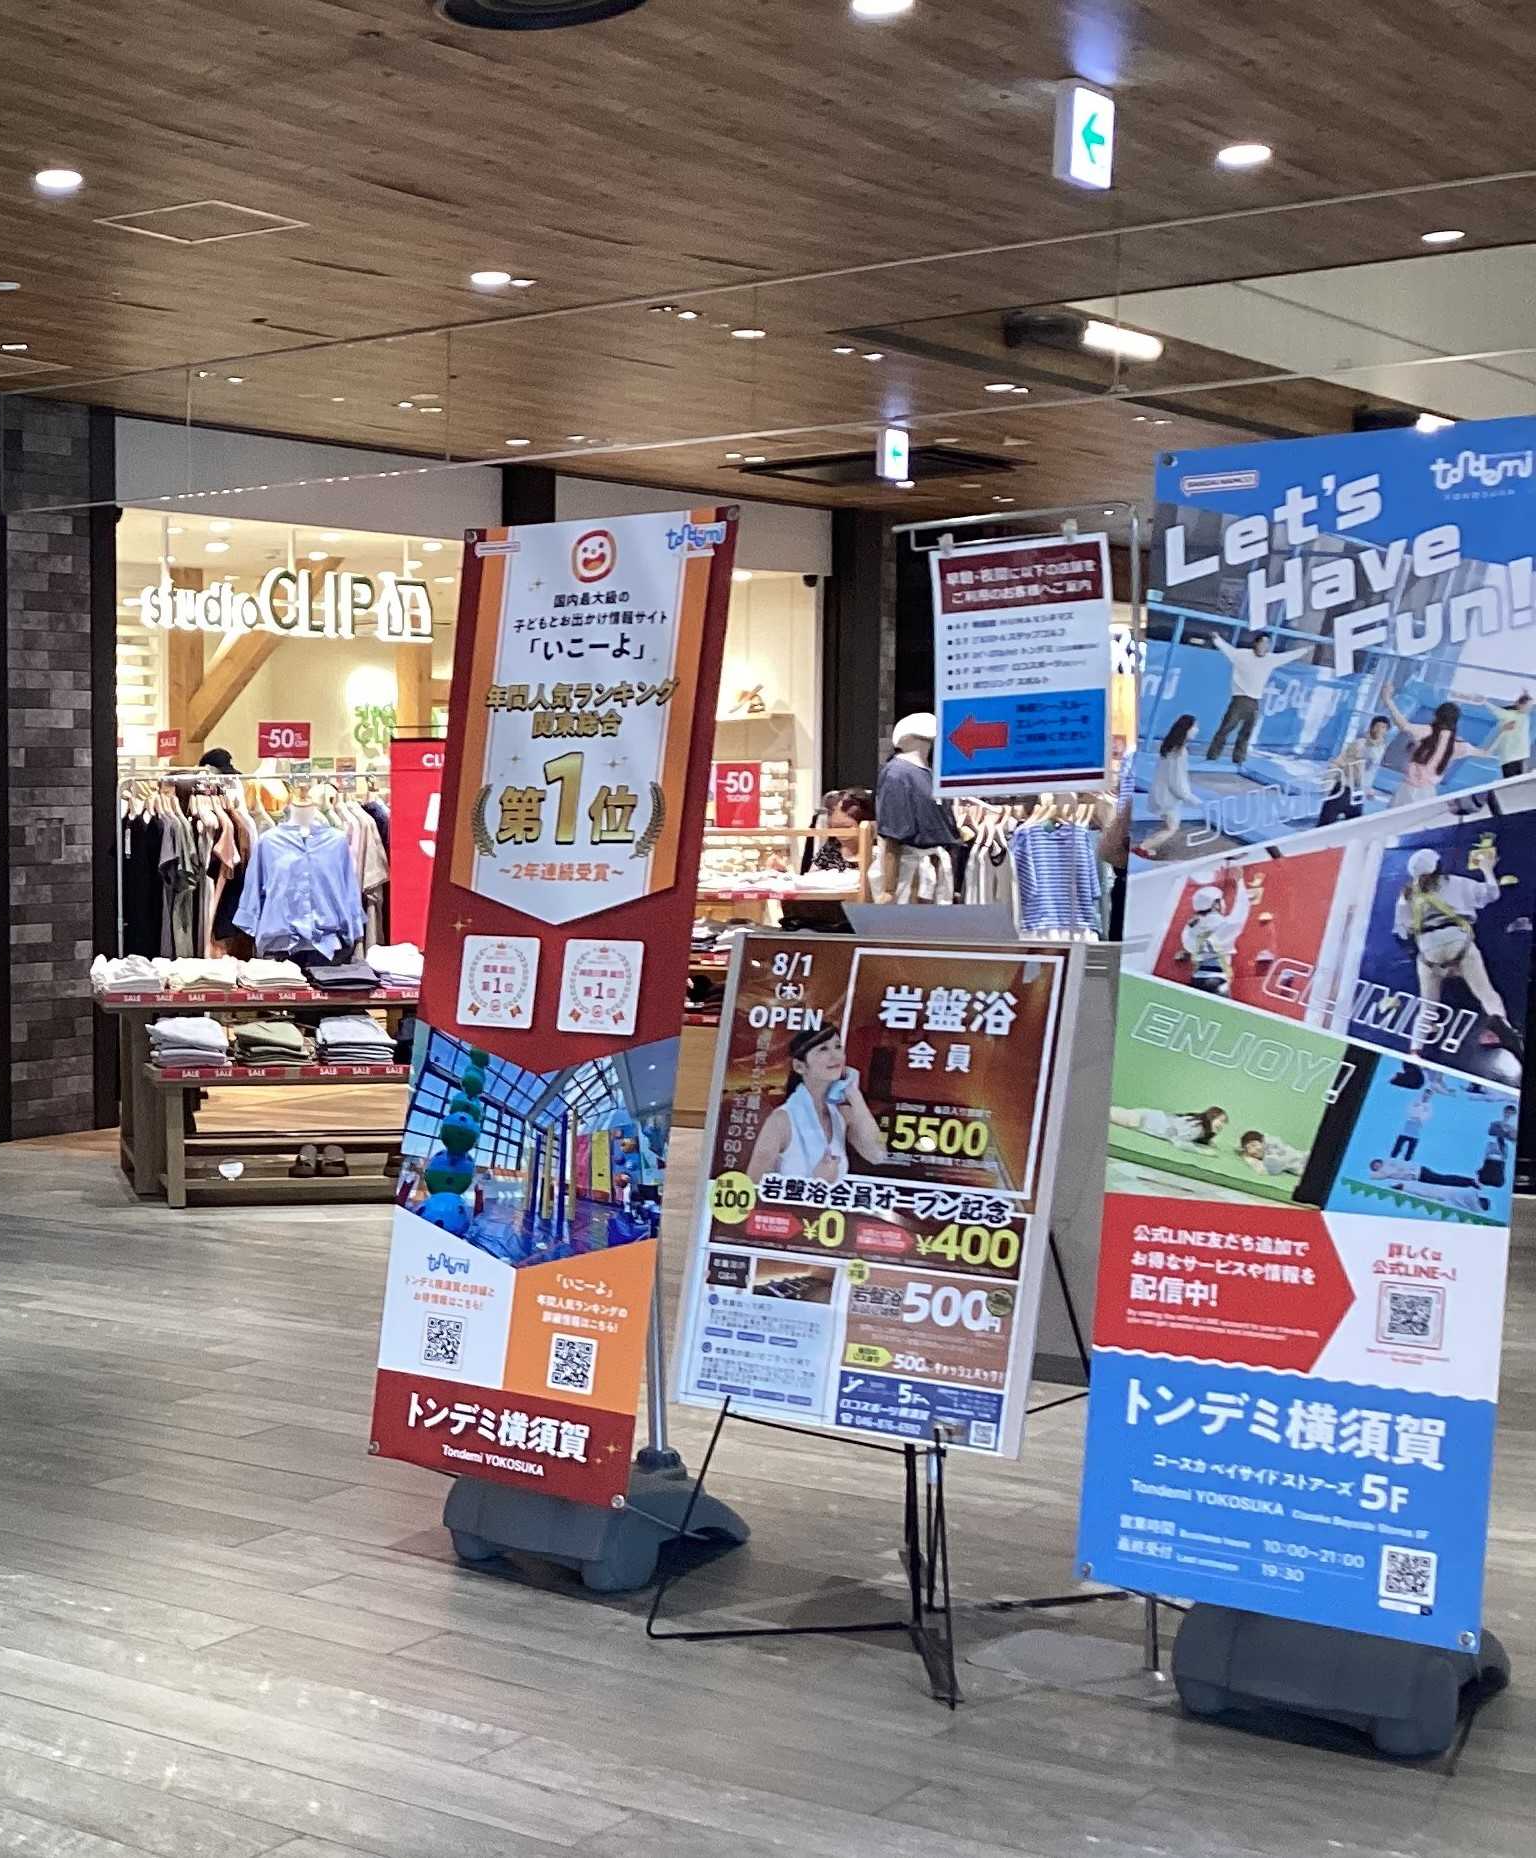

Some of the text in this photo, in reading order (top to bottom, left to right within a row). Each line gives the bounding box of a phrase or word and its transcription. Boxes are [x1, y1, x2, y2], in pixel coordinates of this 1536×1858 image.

[1166, 473, 1383, 587] Let's
[1248, 524, 1461, 632] Have
[141, 567, 376, 640] studio CLIP
[552, 590, 630, 609] 国内最大級の
[1333, 555, 1533, 678] Fun!
[512, 610, 668, 634] 子どもとお出かけ情報サイト
[529, 632, 645, 661] 「いこーよ」
[484, 676, 680, 712] 年間人気ランキング
[531, 709, 623, 739] 関東総合
[159, 736, 177, 748] SALE
[495, 751, 639, 846] 第1位
[1186, 759, 1367, 848] JUMP!
[771, 952, 812, 979] 8/1
[124, 994, 141, 1002] SALE
[188, 993, 205, 1002] SALE
[247, 992, 264, 1001] SALE
[774, 982, 805, 1001] (木)
[748, 1004, 824, 1032] OPEN
[878, 984, 1019, 1036] 岩盤浴
[1131, 1001, 1357, 1104] ENJOY!
[182, 1069, 200, 1079] SALE
[248, 1068, 265, 1077] SALE
[714, 1189, 750, 1209] 100
[761, 1176, 1012, 1224] 岩盤浴会員オープン記念
[916, 1223, 1020, 1269] ¥400
[1133, 1224, 1310, 1257] 公式LINE友だち追加で
[1387, 1242, 1443, 1262] 詳しくは
[1130, 1250, 1316, 1285] お得なサービスや情報を
[556, 1273, 614, 1299] 「いこーよ」
[1130, 1272, 1219, 1307] 配信中!
[536, 1294, 629, 1319] 年間人気ランキングの
[406, 1391, 591, 1463] トンデミ横須賀
[1125, 1376, 1447, 1473] トンデミ横須賀
[441, 1444, 545, 1477] Tondemi YOKOSUKA
[1130, 1478, 1193, 1501] Tondemi
[1194, 1489, 1286, 1517] YOKOSUKA
[1152, 1453, 1208, 1474] コースカ
[1281, 1473, 1355, 1497] ストアーズ
[1358, 1473, 1410, 1514] 5F
[1260, 1563, 1306, 1584] 19:30
